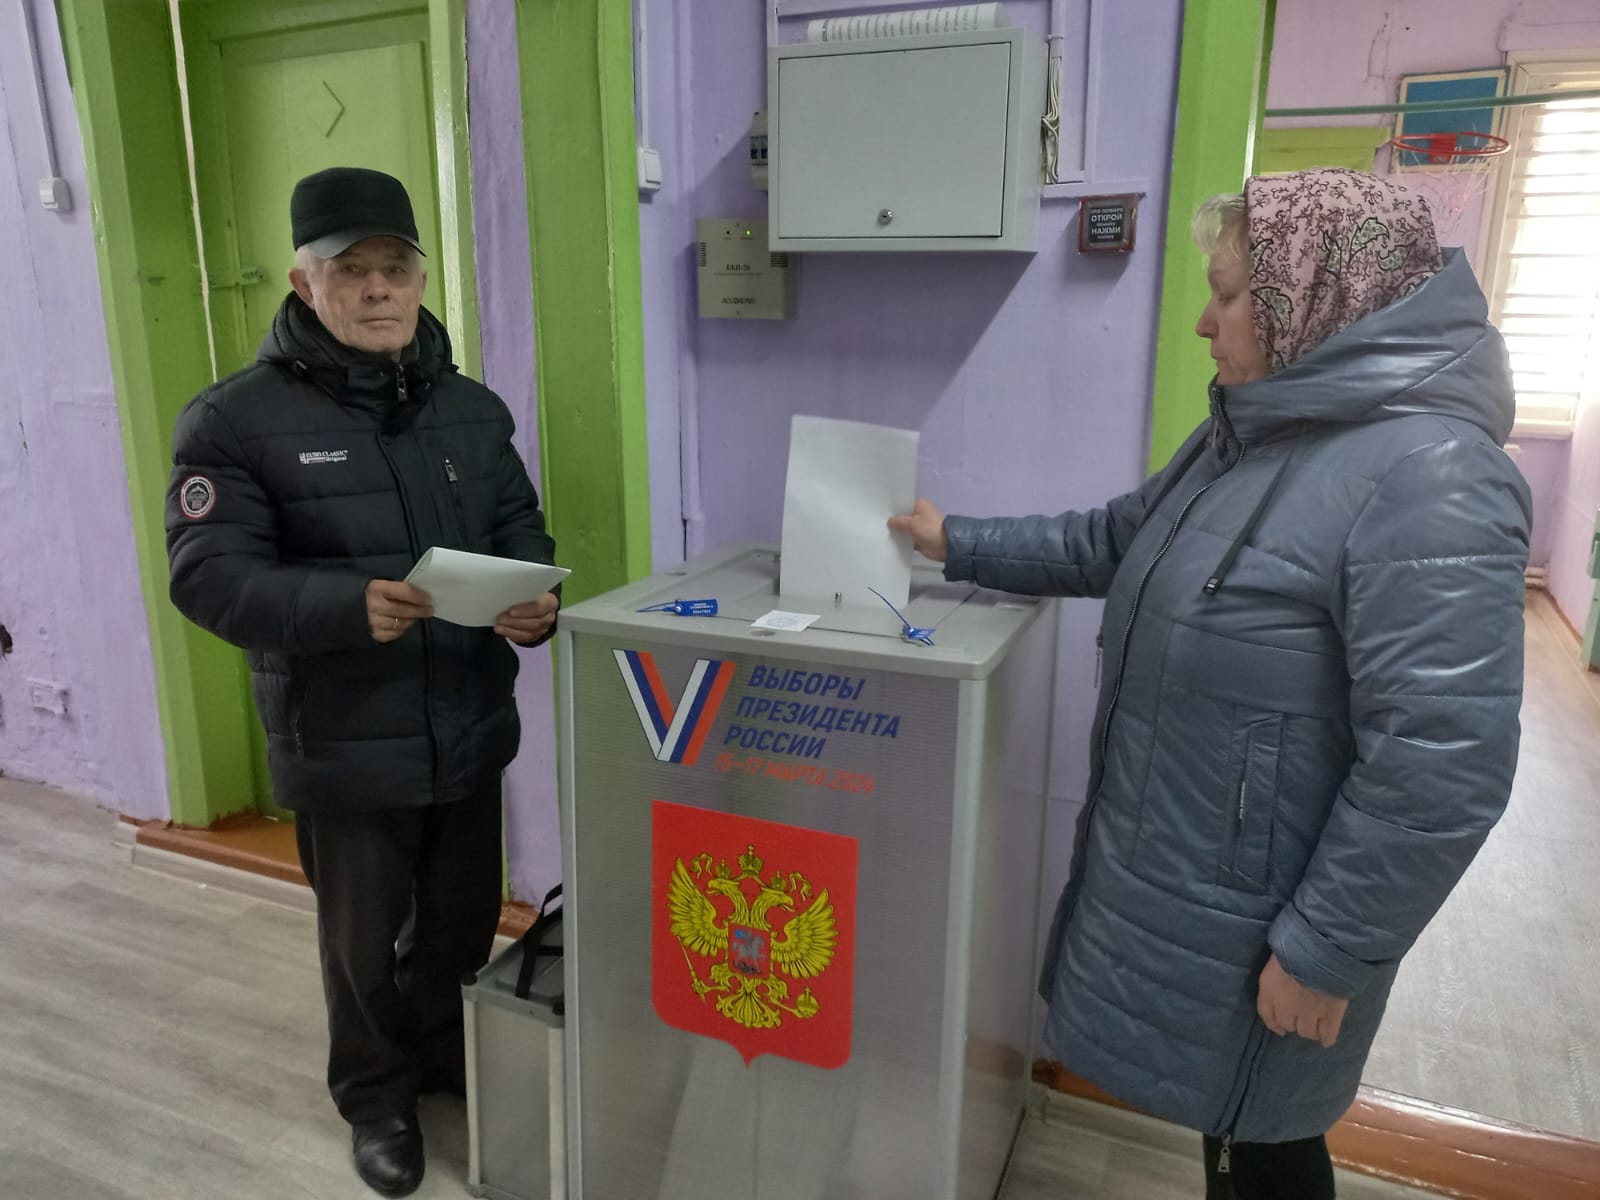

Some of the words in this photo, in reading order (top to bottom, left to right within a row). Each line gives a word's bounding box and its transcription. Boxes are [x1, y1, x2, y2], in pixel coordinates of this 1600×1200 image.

[1091, 213, 1122, 222] ОТКРОЙ
[1091, 226, 1121, 235] НАЖМИ
[748, 664, 867, 701] ВЫБОРЫ
[735, 695, 901, 739] ПРЕЗИДЕНТА
[723, 725, 826, 760] РОССИИ
[763, 759, 826, 787] МАРТА
[828, 769, 876, 794] 2024
